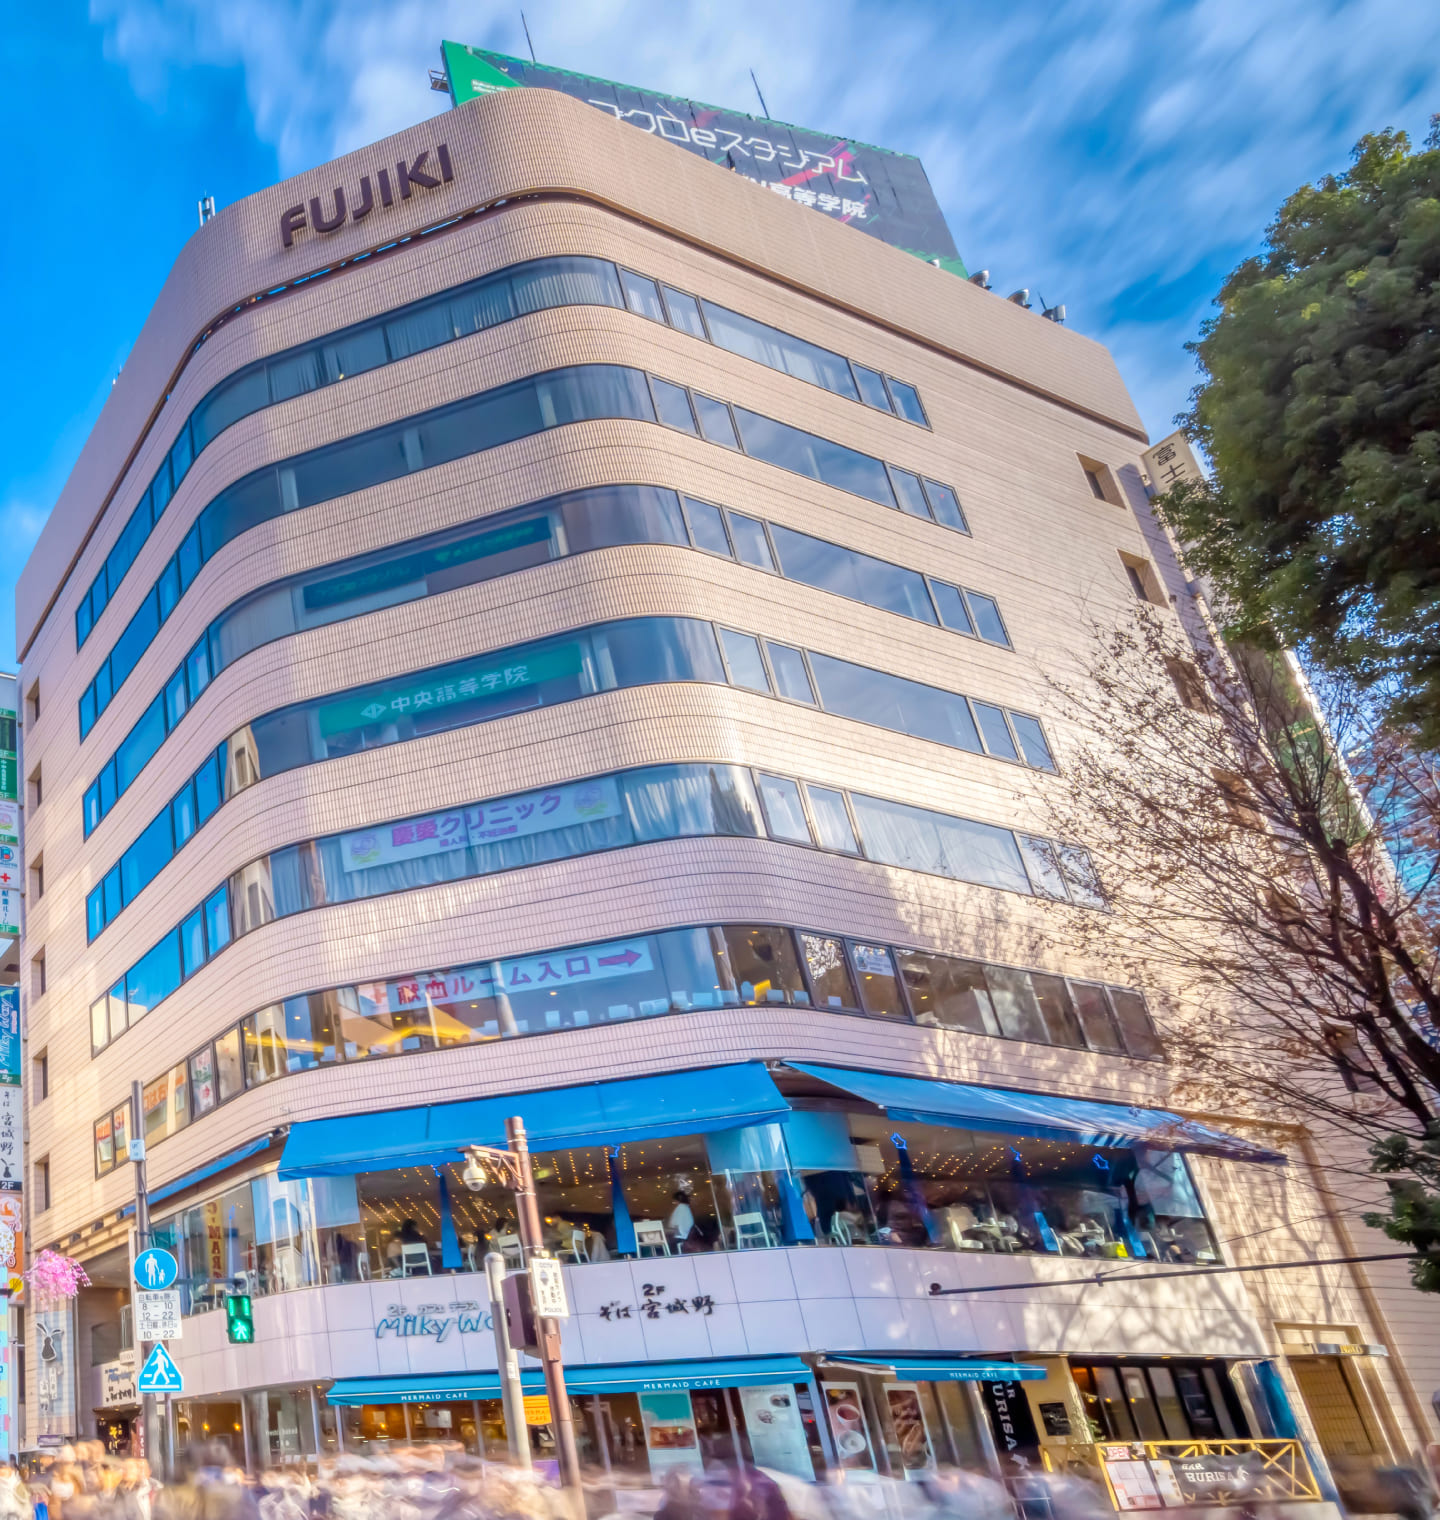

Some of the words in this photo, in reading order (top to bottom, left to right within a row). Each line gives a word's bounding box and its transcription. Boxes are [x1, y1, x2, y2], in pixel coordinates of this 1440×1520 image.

[280, 143, 454, 248] FUJIKI
[742, 175, 867, 218] 高等学院
[1152, 442, 1186, 484] 富士
[391, 665, 529, 713] 中央高等学院
[392, 793, 560, 848] 慶愛クリニック
[1, 1181, 14, 1190] 2F
[642, 1283, 665, 1297] 2F
[142, 1302, 148, 1311] 8
[164, 1301, 173, 1310] 10
[142, 1311, 151, 1321] 12
[162, 1311, 174, 1320] 22
[600, 1300, 632, 1321] そば
[640, 1295, 715, 1319] 宮城野
[143, 1330, 152, 1340] 10
[163, 1329, 175, 1339] 22
[375, 1313, 451, 1343] Milky
[458, 1310, 494, 1334] Wa
[643, 1381, 690, 1390] MERMAID
[400, 1393, 441, 1401] MERMAID
[992, 1384, 1018, 1451] URISA
[1184, 1471, 1235, 1483] BURISA
